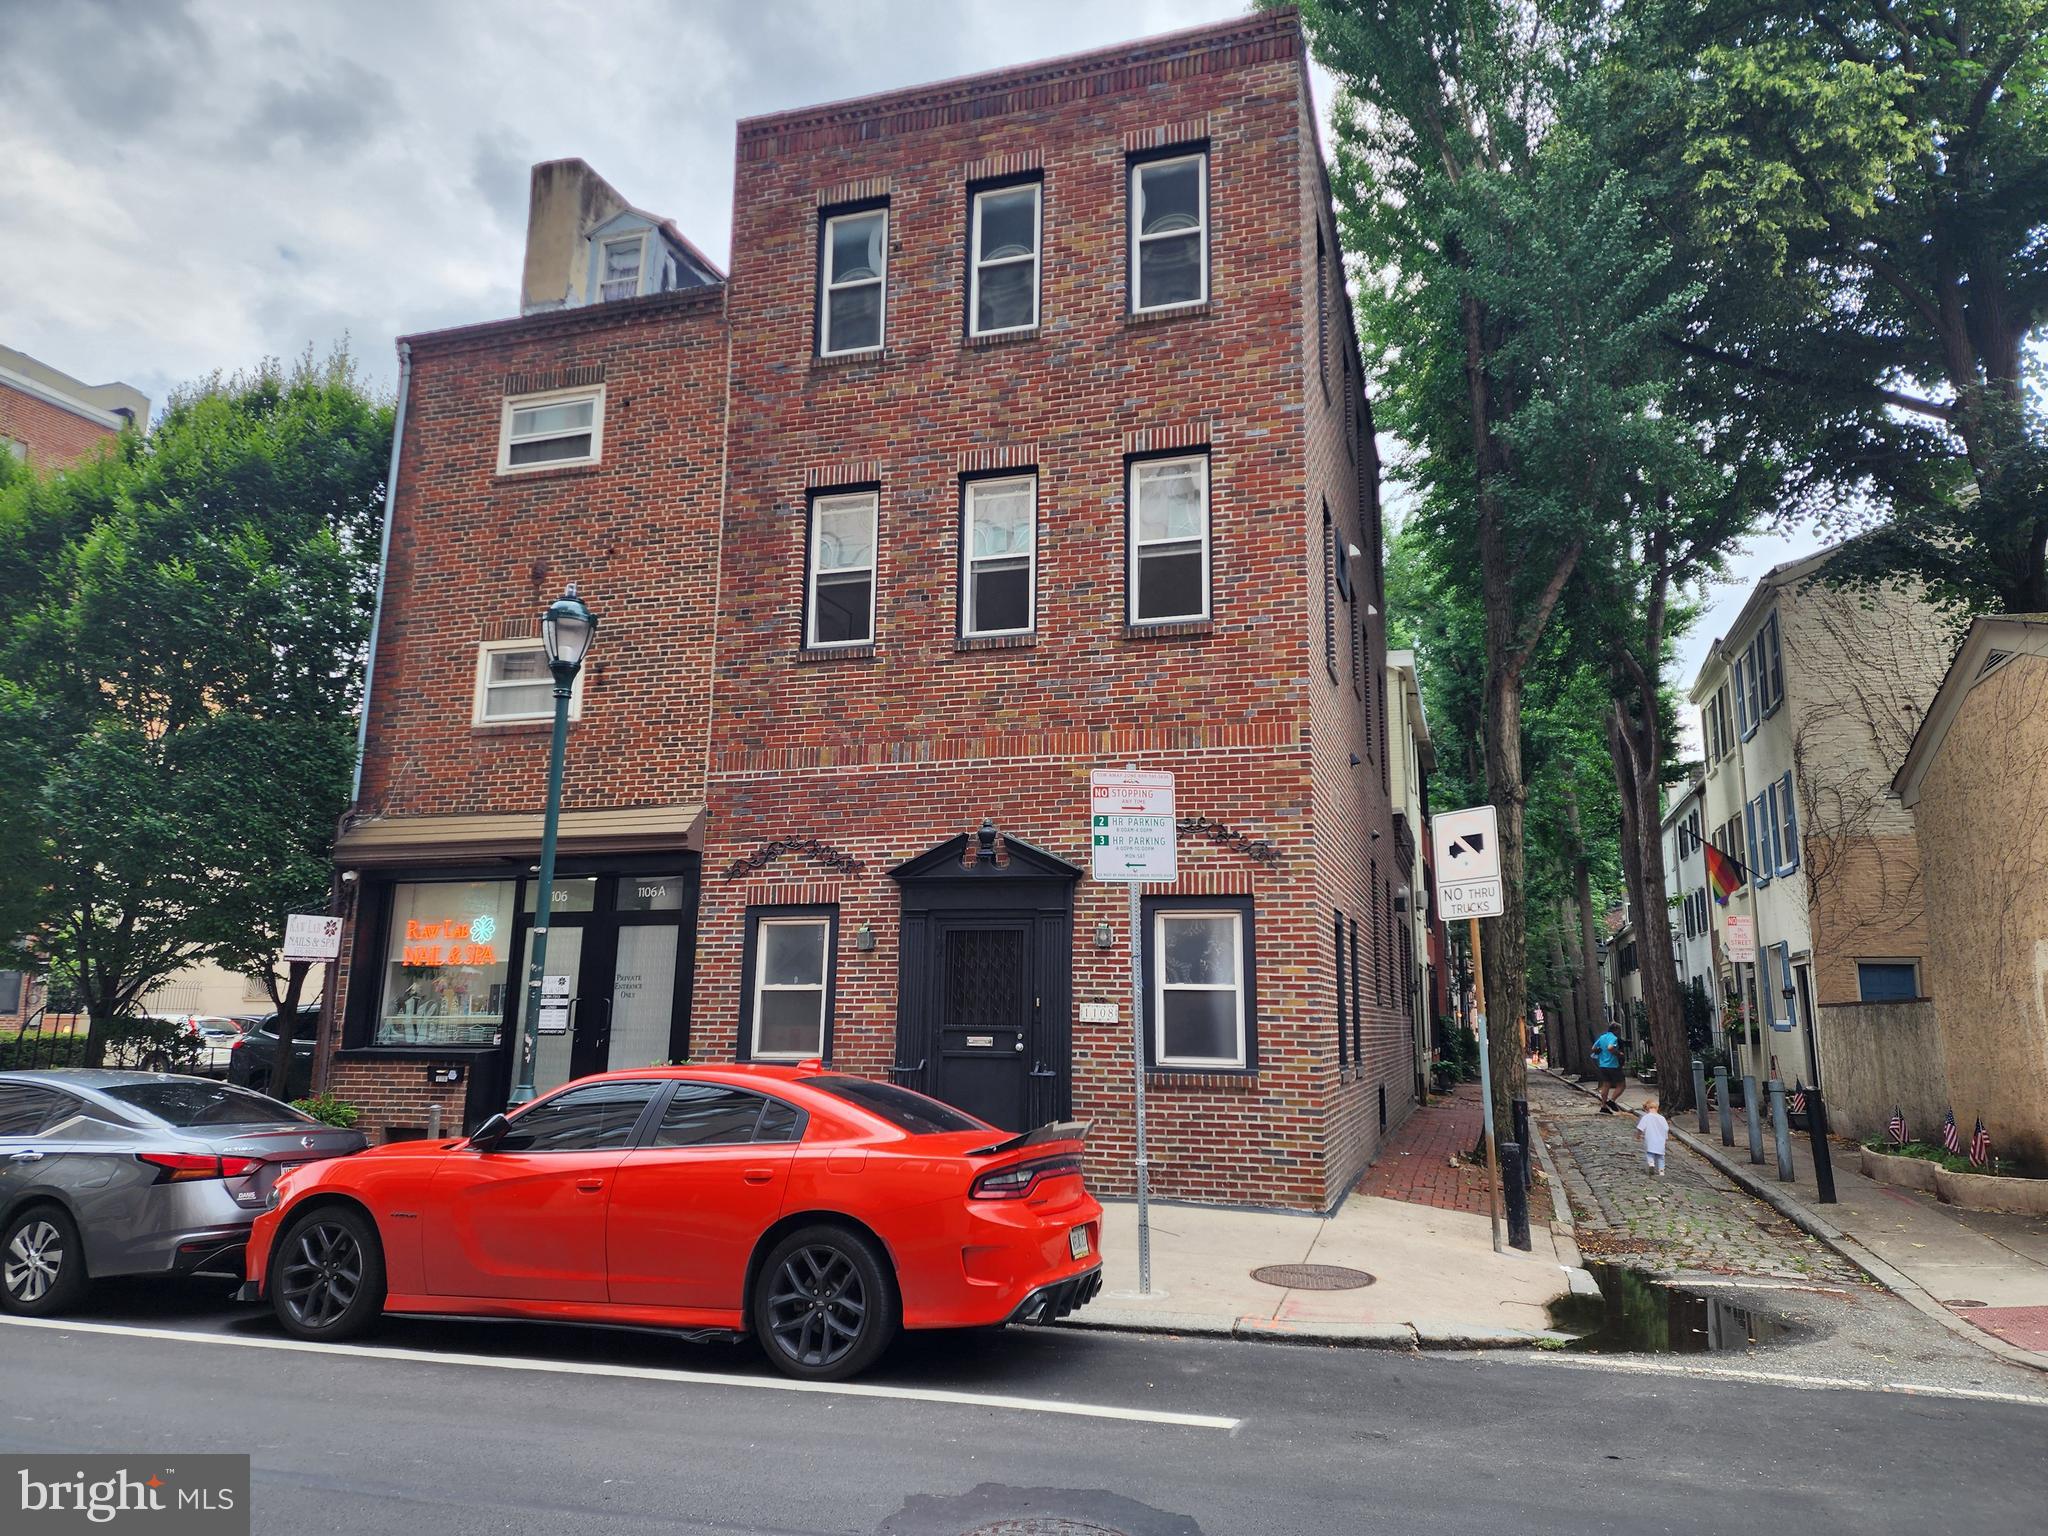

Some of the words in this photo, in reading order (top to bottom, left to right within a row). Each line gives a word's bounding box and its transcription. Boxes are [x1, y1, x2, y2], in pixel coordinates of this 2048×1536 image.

[1094, 788, 1108, 798] NO
[1111, 789, 1154, 799] STOPPING
[1098, 816, 1105, 826] 2
[1112, 817, 1124, 826] HR
[1128, 817, 1165, 827] PARKING
[1099, 836, 1105, 845] 3
[1112, 836, 1124, 845] HR
[1128, 836, 1166, 846] PARKING
[551, 890, 568, 902] 106
[1444, 887, 1463, 902] NO
[1469, 886, 1496, 899] THRU
[1451, 901, 1490, 914] TRUCKS
[402, 945, 444, 966] NAIL
[447, 945, 462, 965] &
[463, 944, 497, 966] SPA
[1085, 1008, 1114, 1018] 1108
